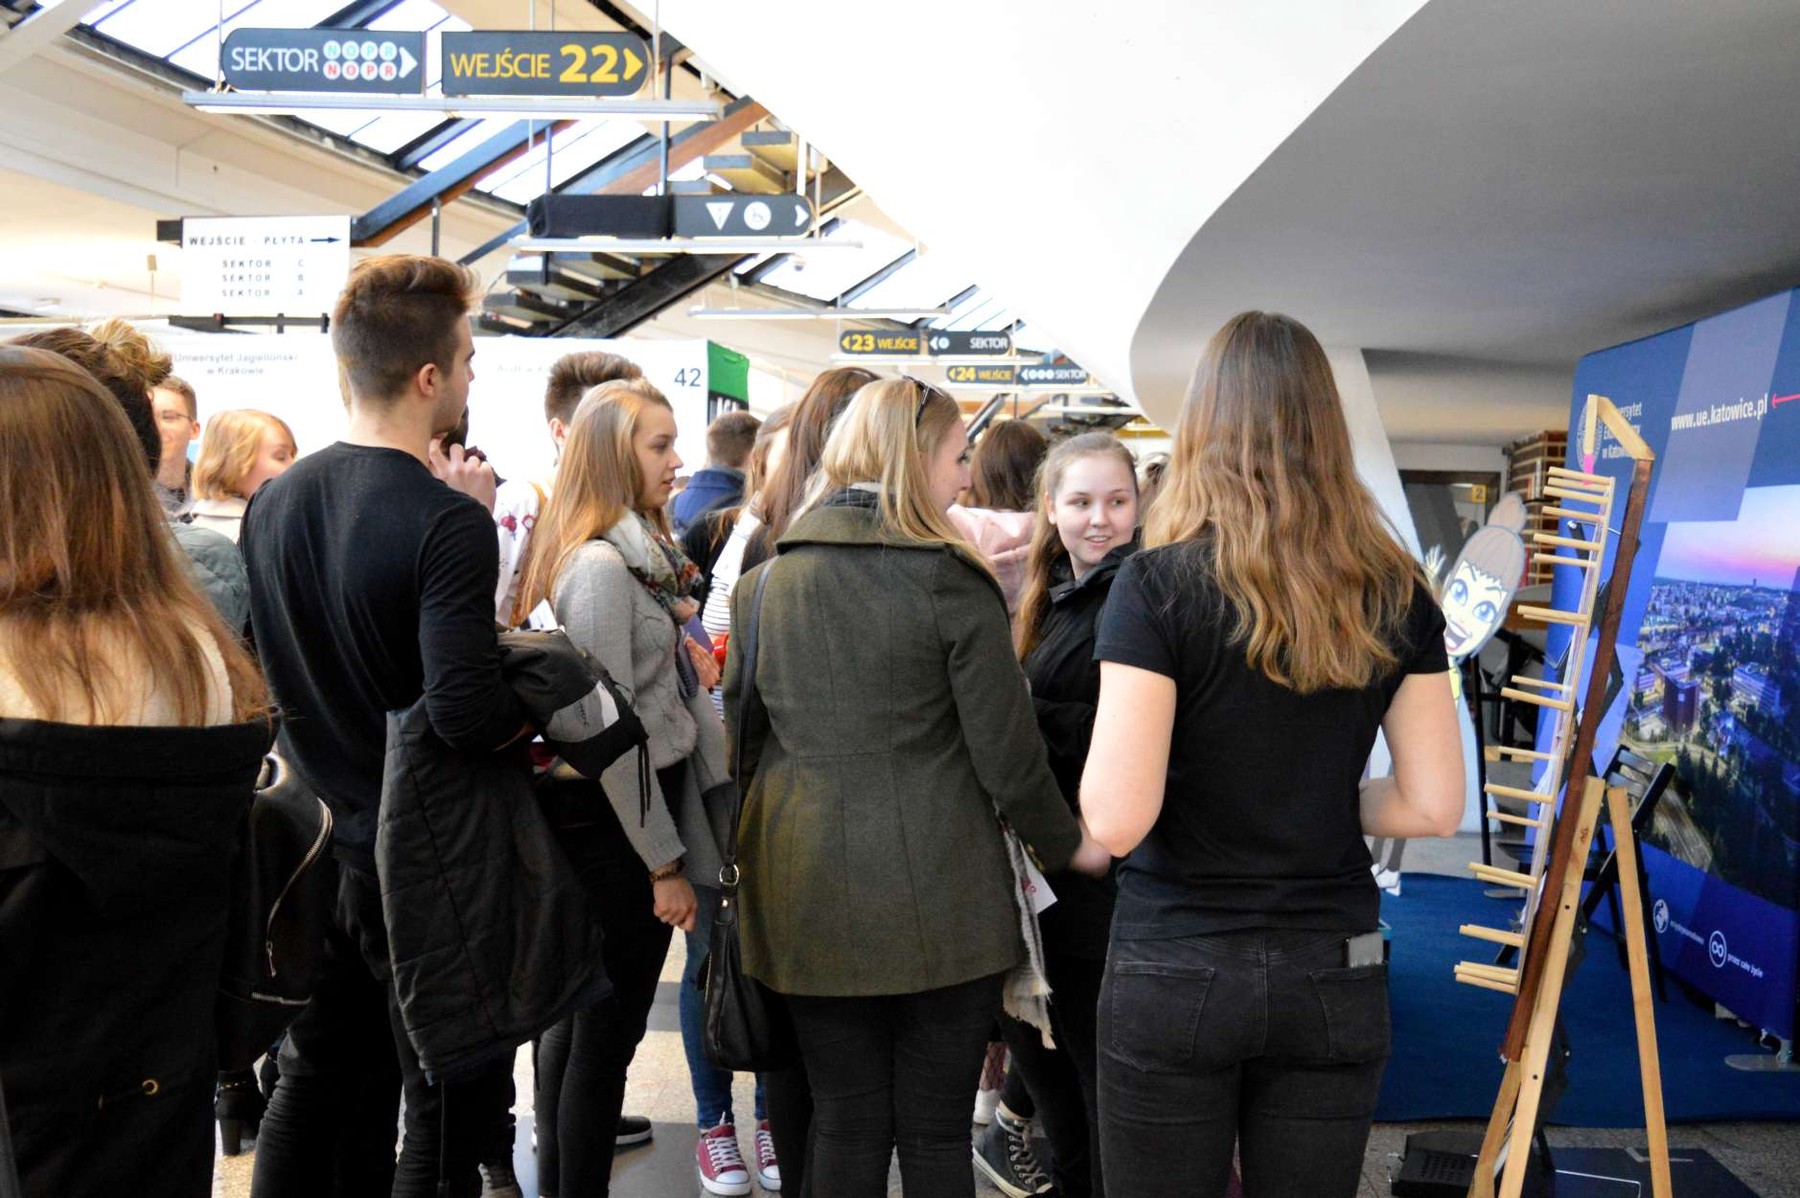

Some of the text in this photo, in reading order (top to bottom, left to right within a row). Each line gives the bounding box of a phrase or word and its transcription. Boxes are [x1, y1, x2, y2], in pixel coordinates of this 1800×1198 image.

[231, 47, 319, 72] SEKTOR
[450, 44, 619, 83] WEJŚCIE 22
[189, 235, 305, 246] WEJŚCIE PŁYTA
[222, 260, 272, 268] SEKTOR
[222, 274, 271, 282] SEKTOR
[222, 289, 271, 297] SEKTOR
[851, 335, 919, 351] 23 WEJŚCIE
[969, 337, 1008, 349] SEKTOR
[674, 368, 702, 387] 42
[955, 367, 976, 381] 24
[1670, 392, 1768, 431] www.ue.katowice.pl
